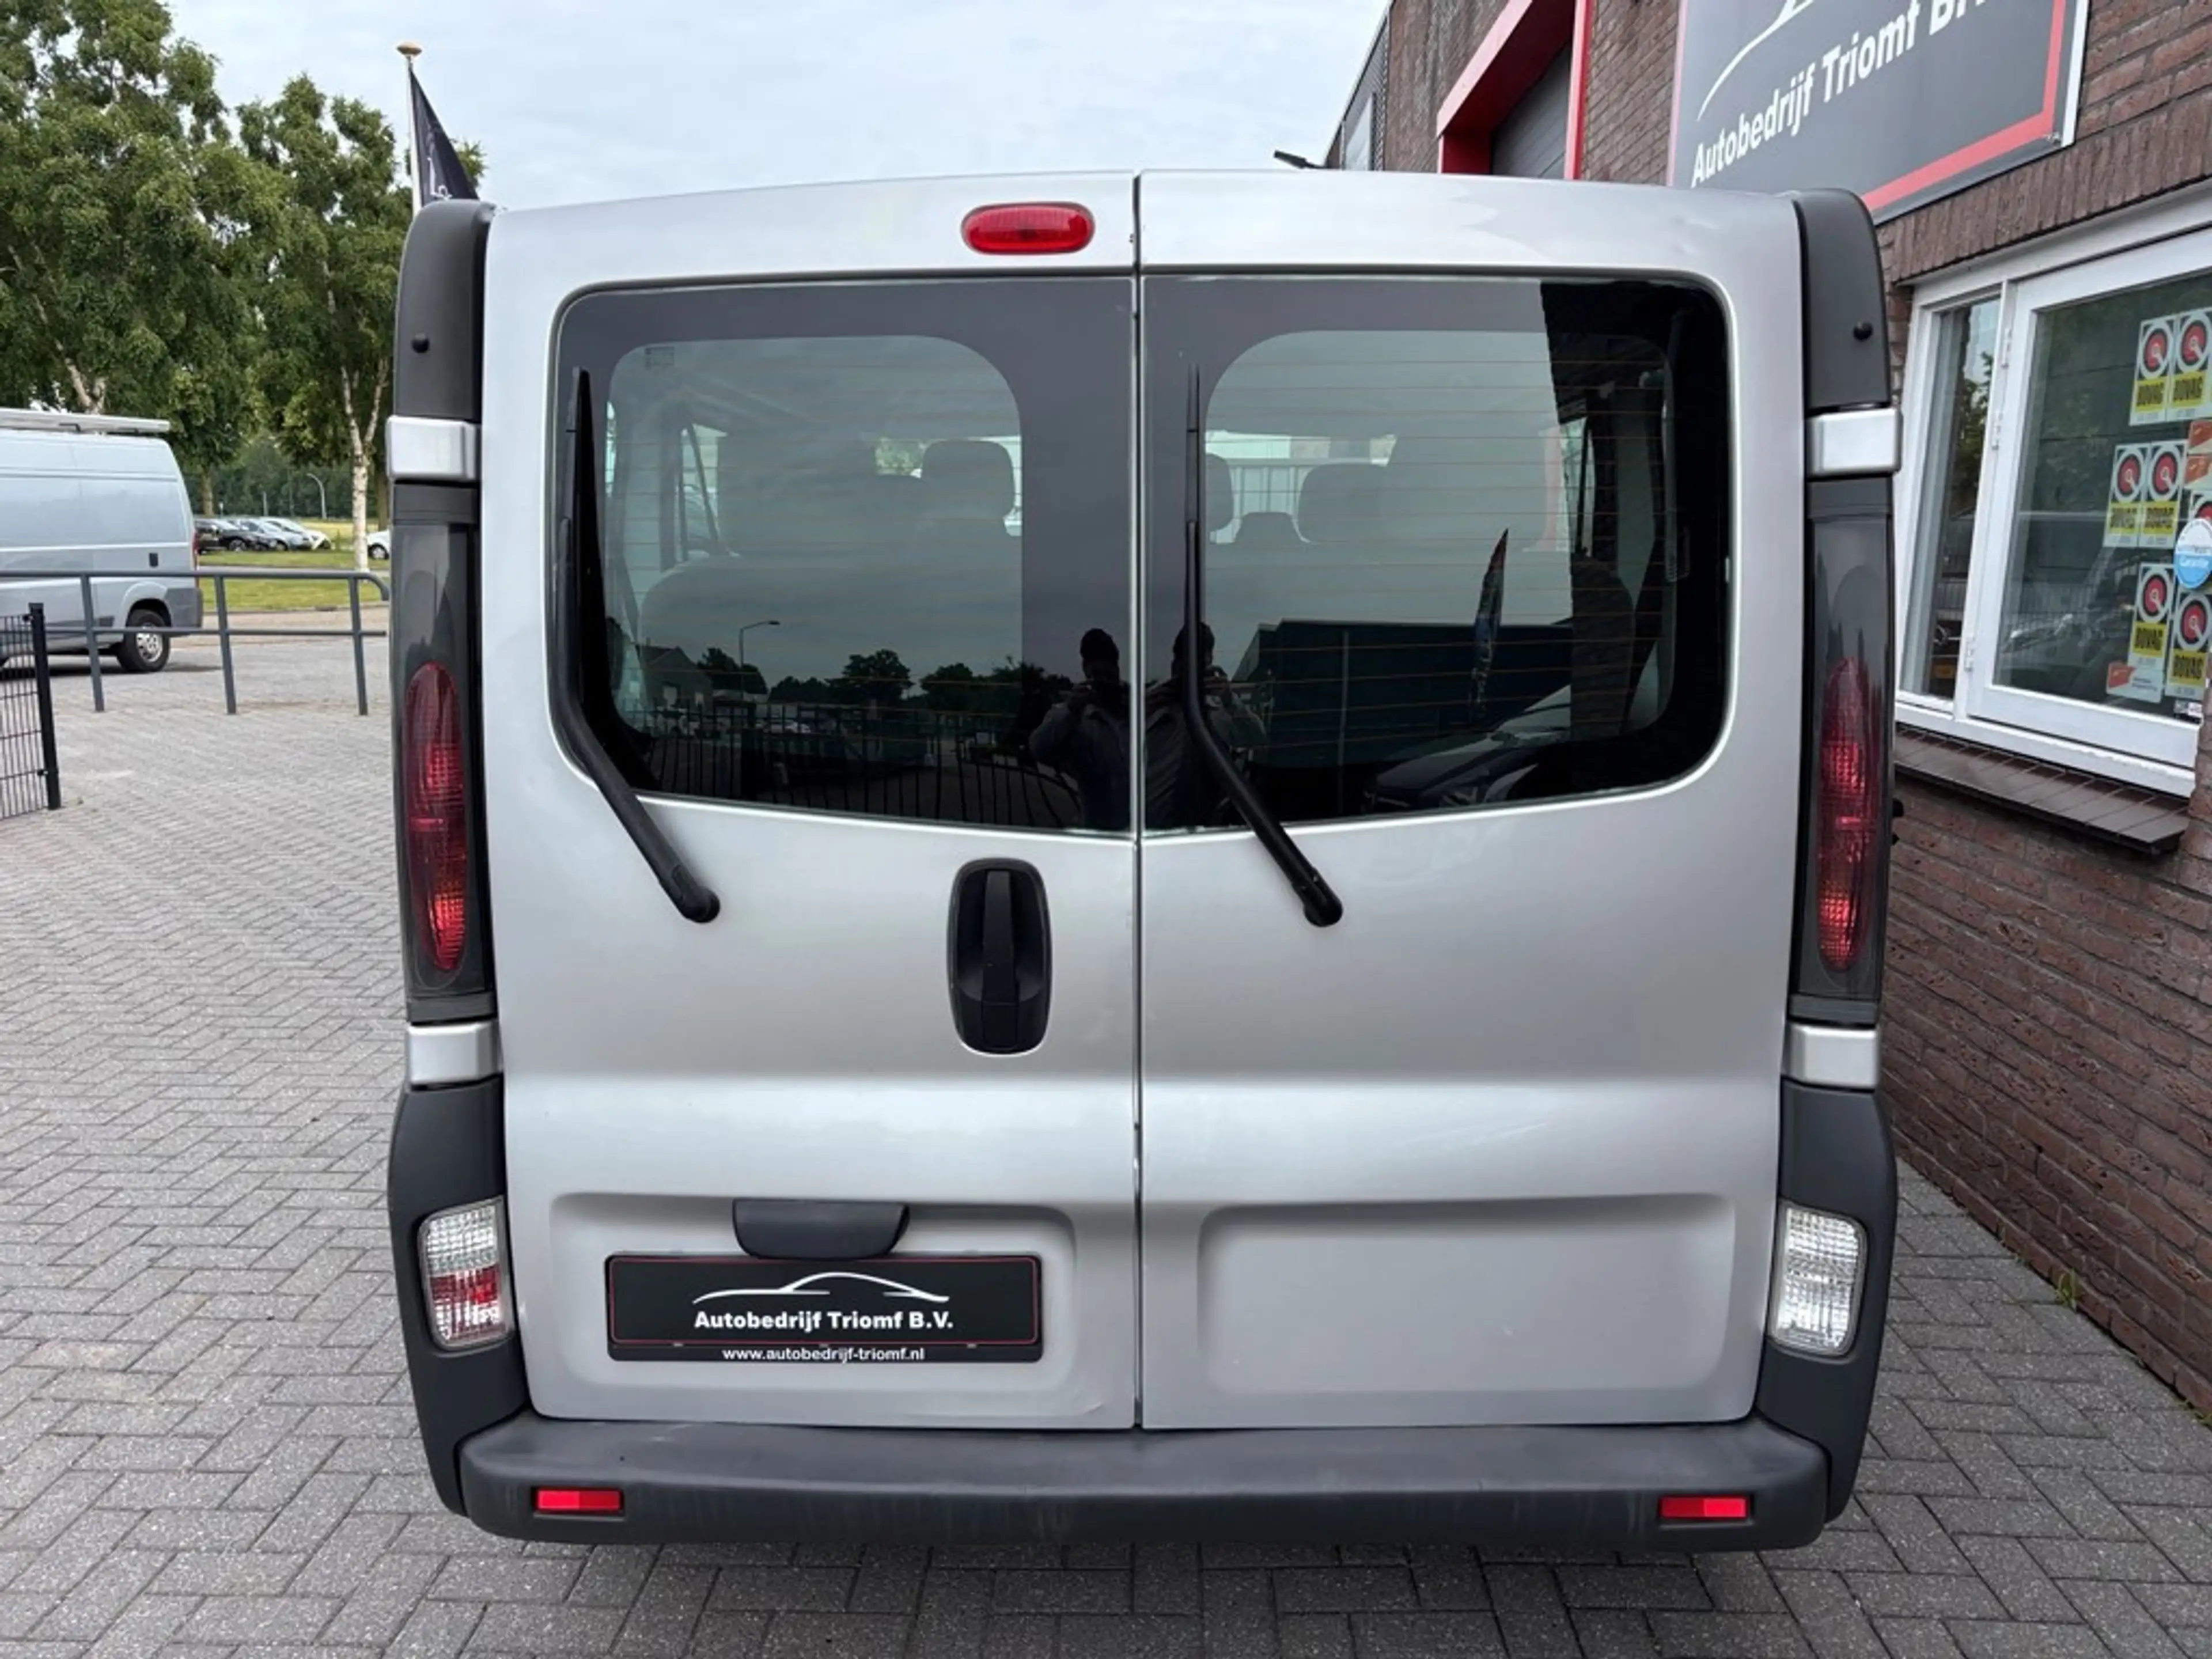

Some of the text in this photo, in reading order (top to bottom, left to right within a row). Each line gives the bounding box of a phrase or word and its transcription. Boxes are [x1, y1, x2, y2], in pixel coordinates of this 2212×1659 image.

[1691, 62, 1816, 188] Autobedrijf
[1822, 0, 1921, 103] Triomf
[694, 1310, 953, 1332] Autobedrijf Triomf B.V.
[722, 1347, 925, 1363] www.autobedrijf-triomf.nl
